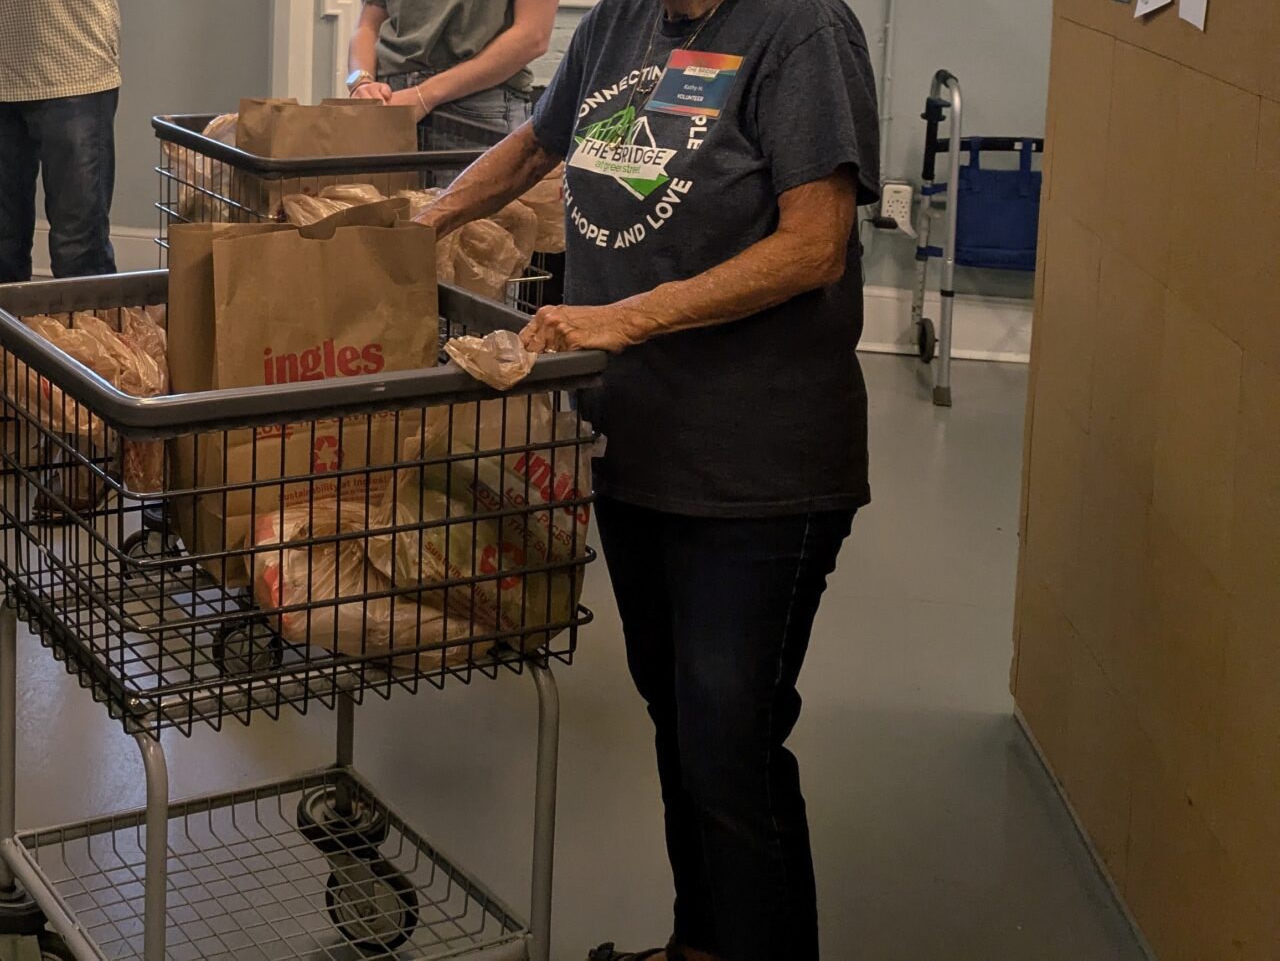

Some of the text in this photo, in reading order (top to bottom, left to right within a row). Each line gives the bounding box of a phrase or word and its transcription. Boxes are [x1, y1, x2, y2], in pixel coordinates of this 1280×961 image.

[578, 65, 662, 117] ONNECTIN
[580, 139, 667, 166] THE BRIDGE
[687, 115, 708, 150] PLE
[571, 206, 609, 247] HOPE
[614, 223, 646, 248] AND
[646, 178, 693, 229] LOVE
[264, 338, 385, 385] ingles
